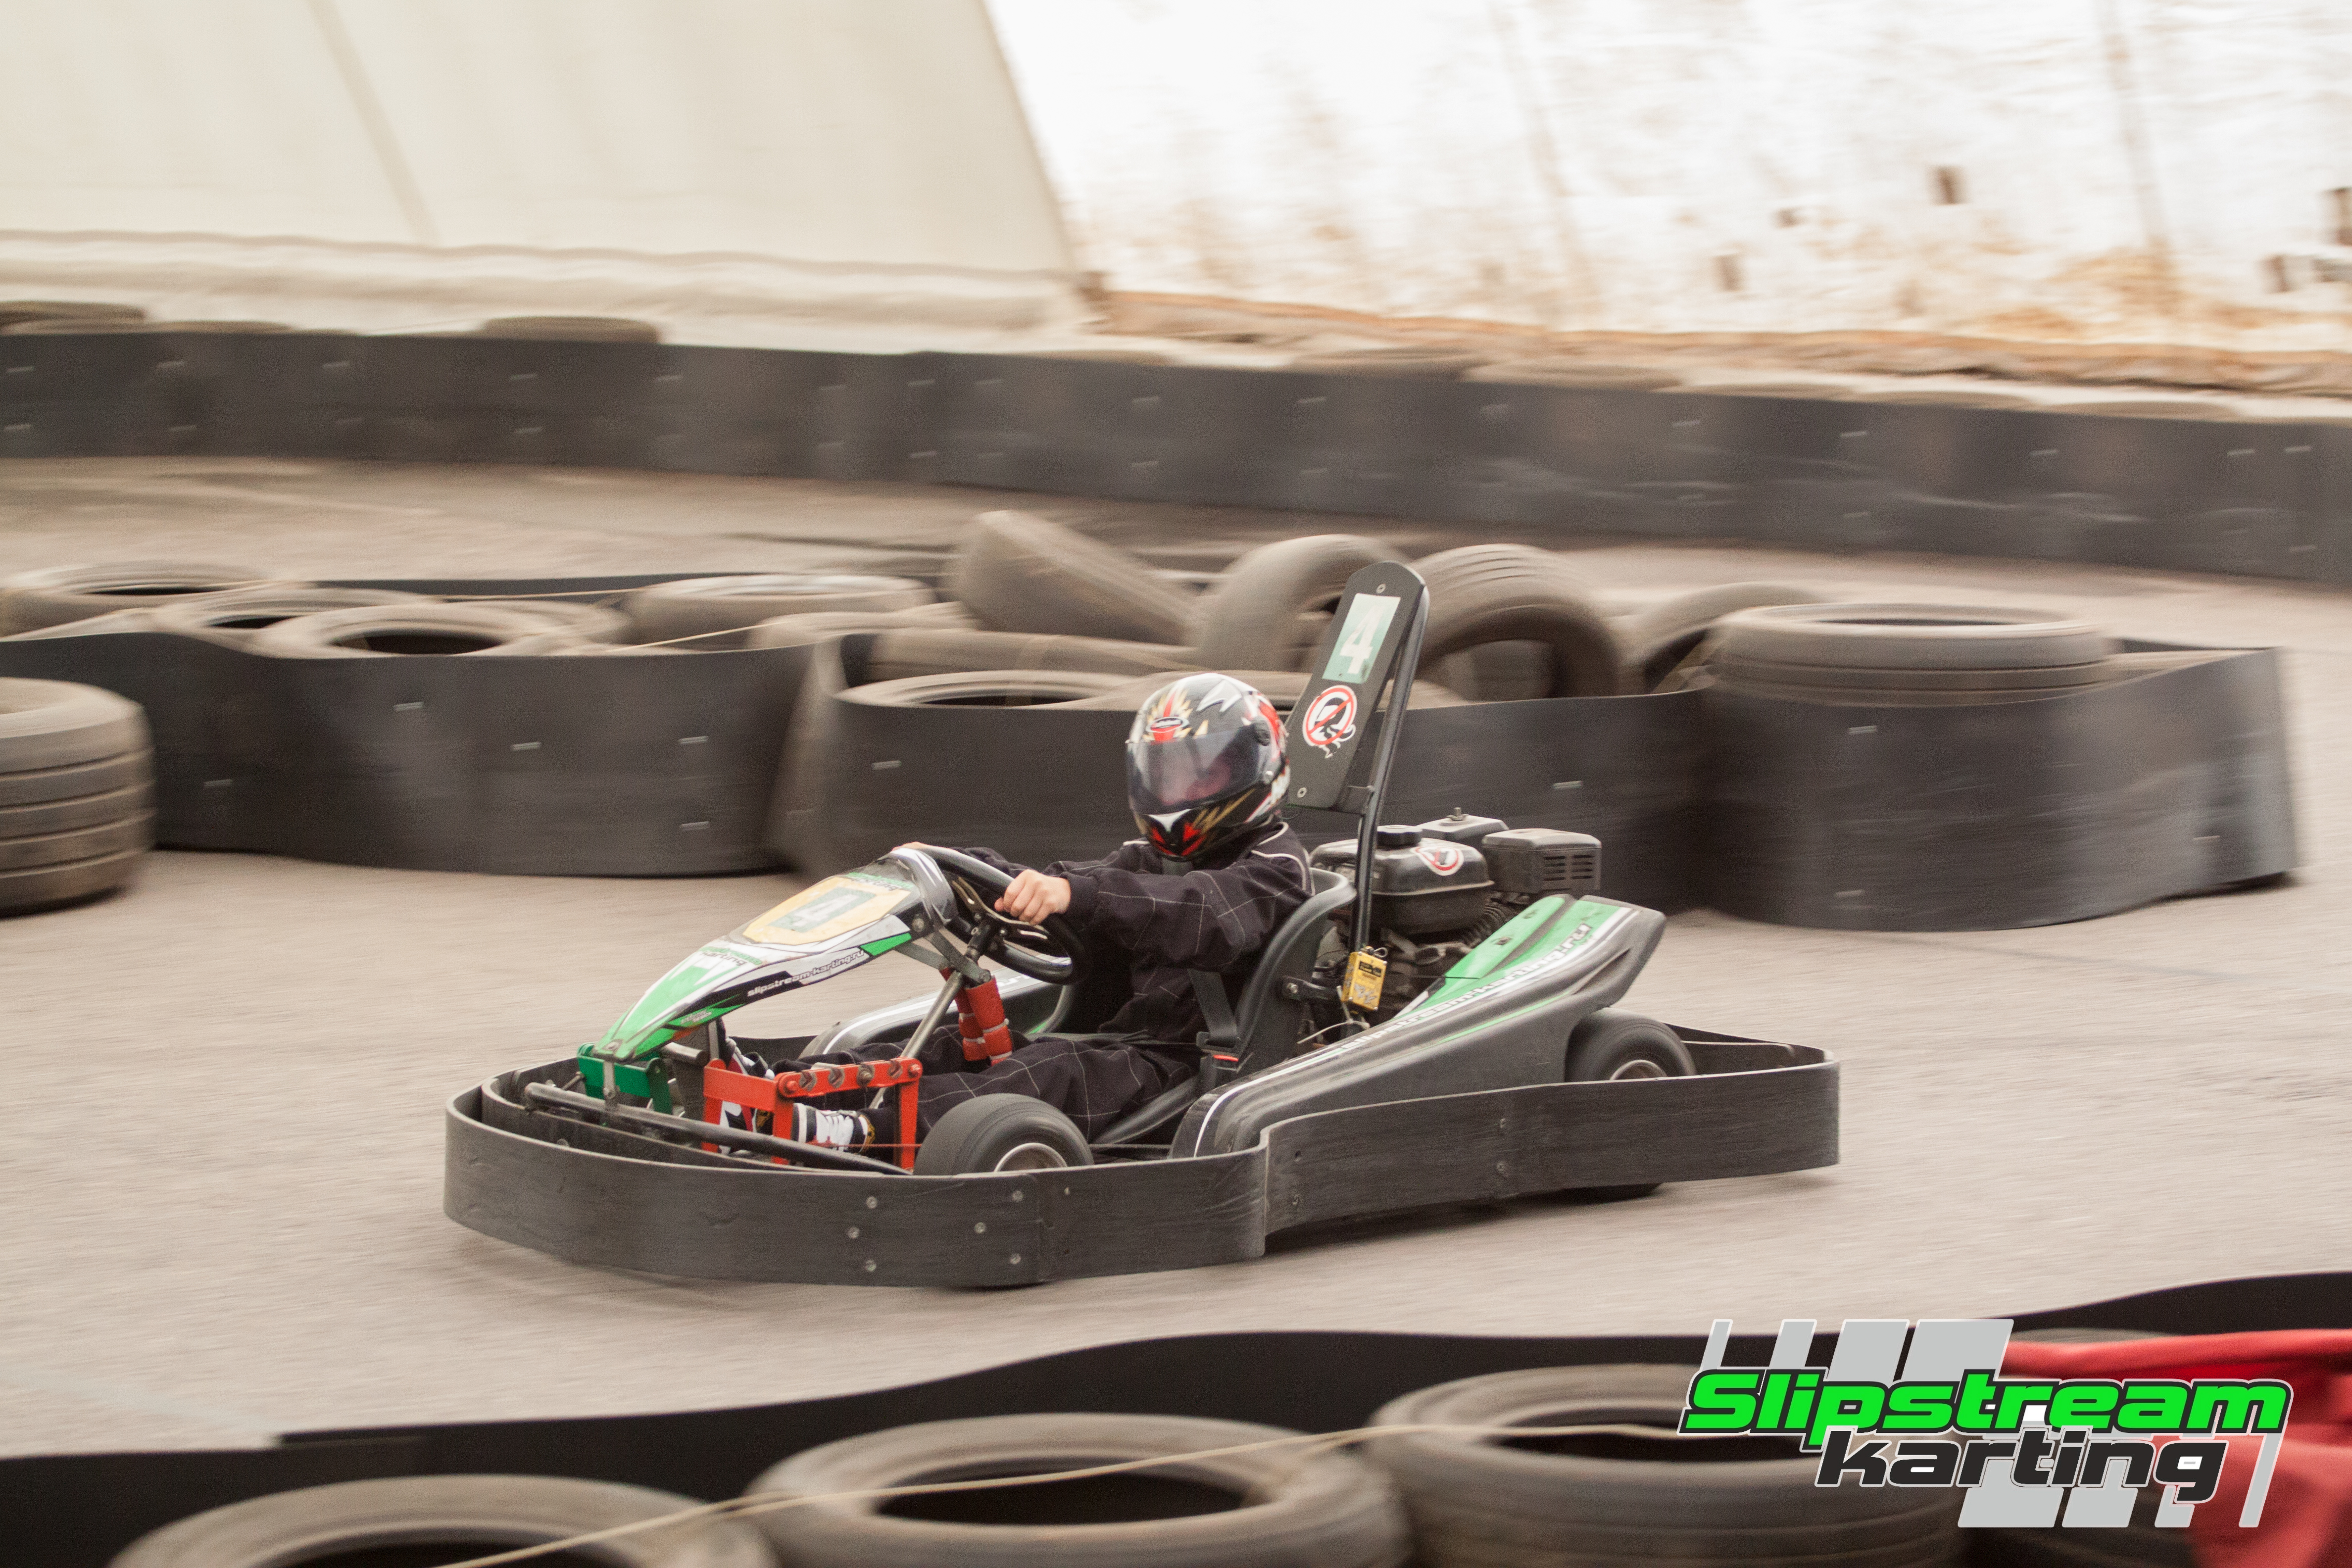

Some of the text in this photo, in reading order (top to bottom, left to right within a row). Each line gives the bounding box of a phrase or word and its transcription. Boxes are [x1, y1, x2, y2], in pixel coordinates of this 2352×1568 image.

[1338, 603, 1385, 675] 4
[789, 893, 860, 928] 4
[747, 950, 865, 997] slipstream-karting.ru
